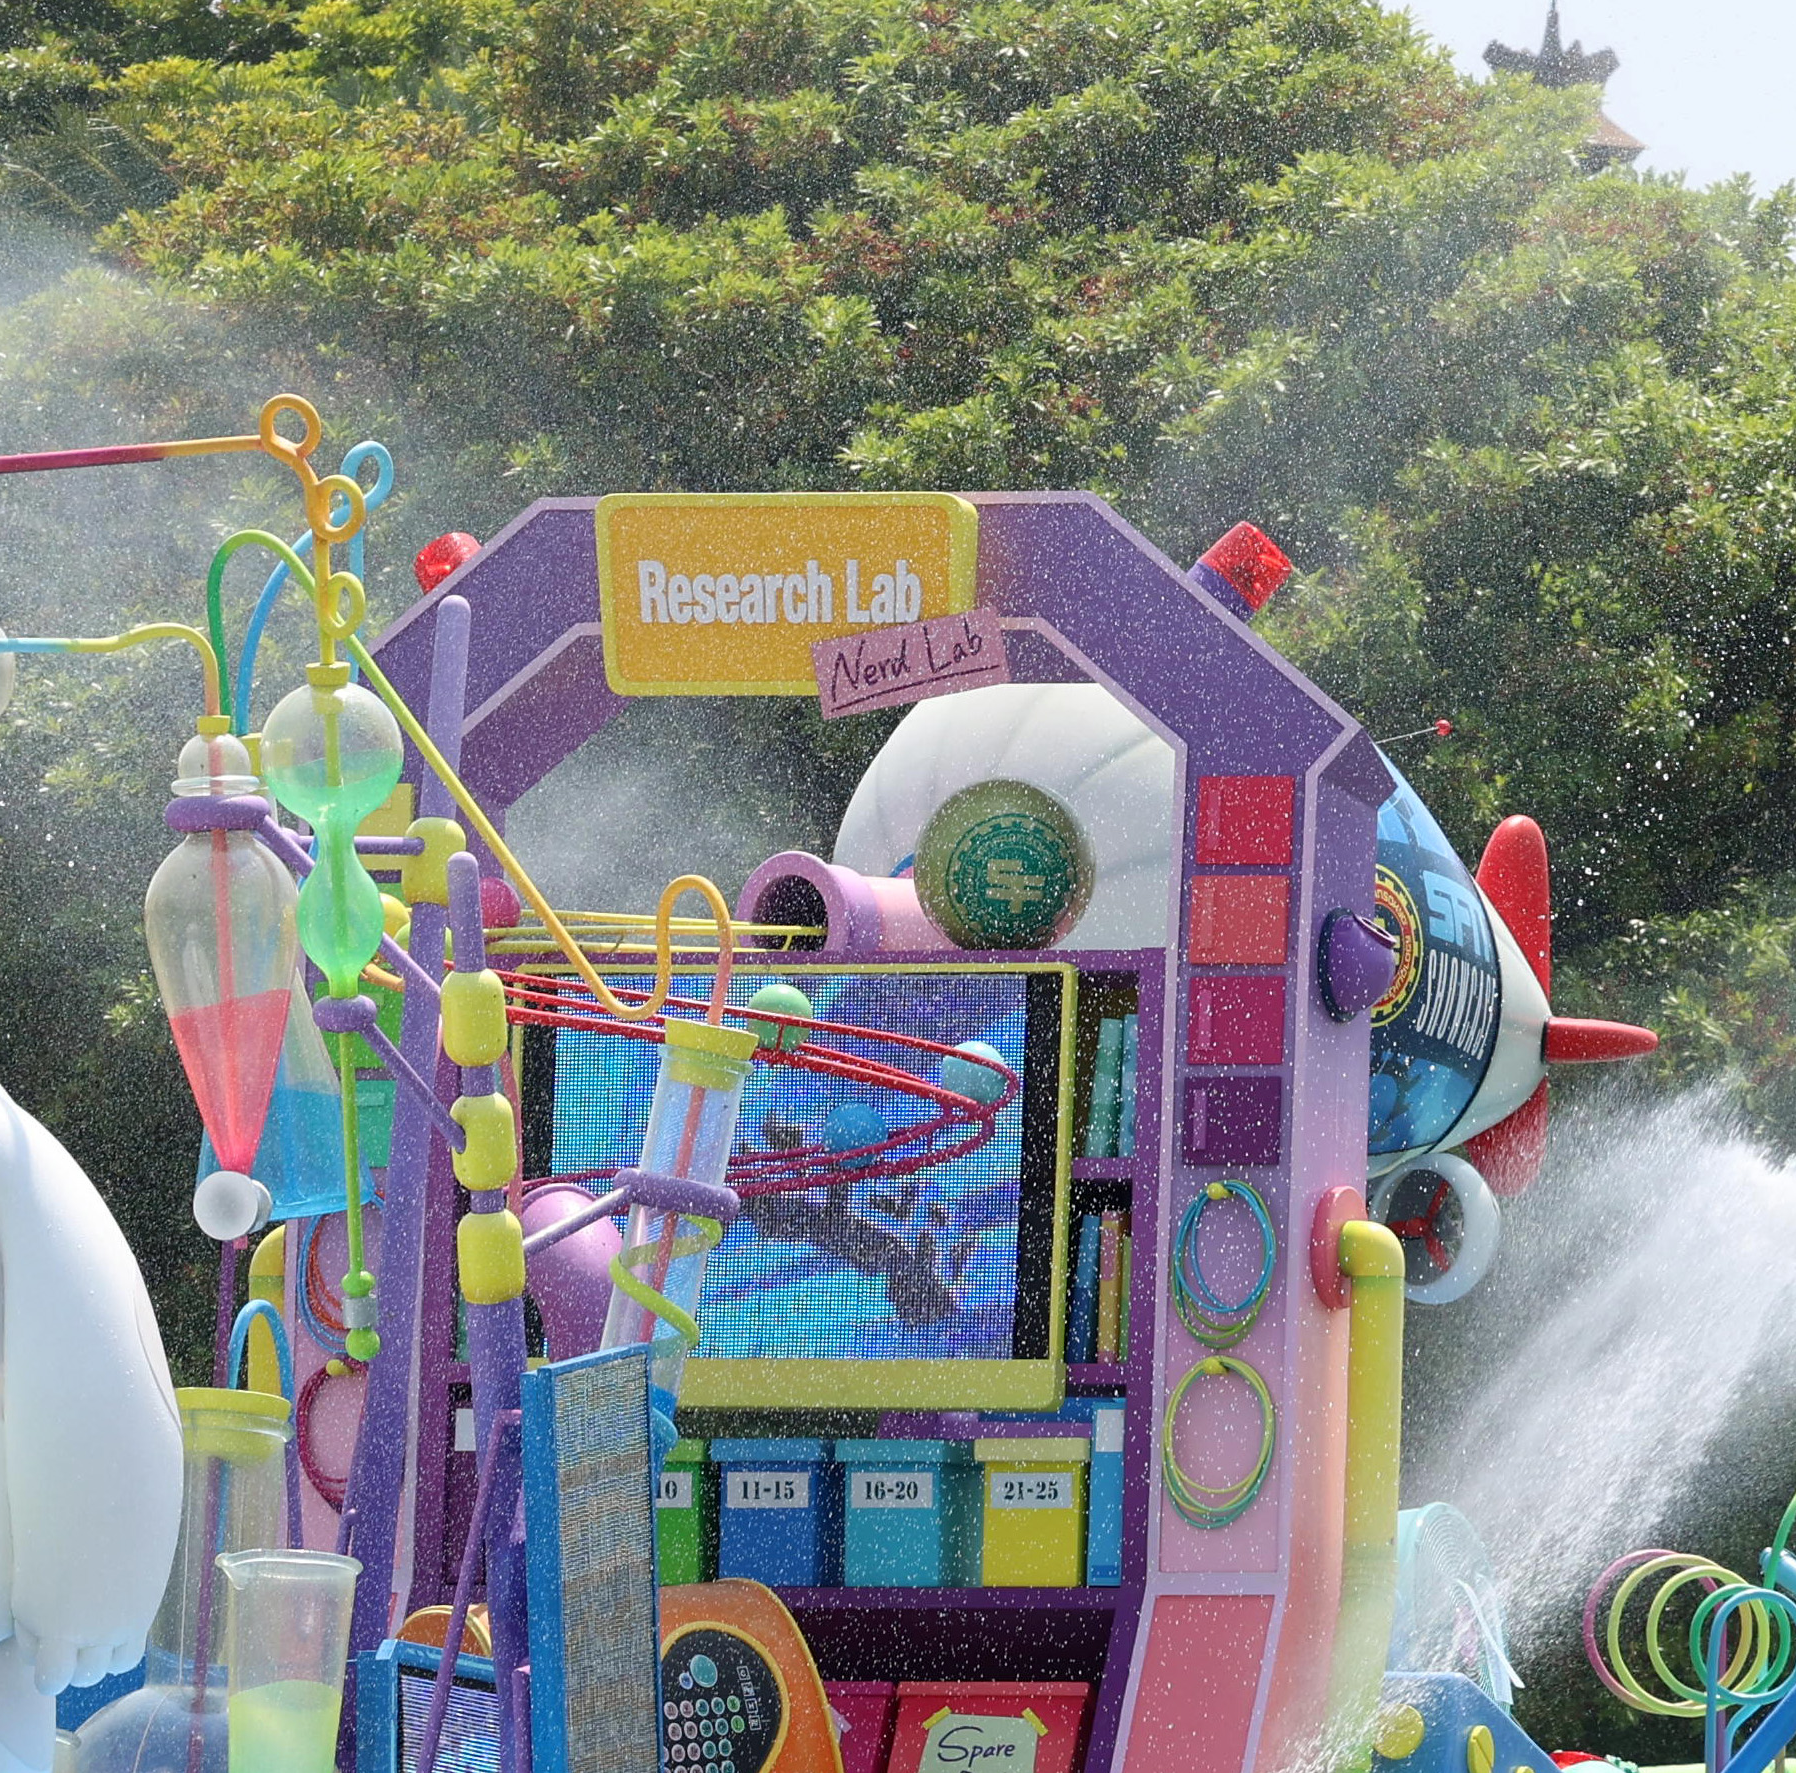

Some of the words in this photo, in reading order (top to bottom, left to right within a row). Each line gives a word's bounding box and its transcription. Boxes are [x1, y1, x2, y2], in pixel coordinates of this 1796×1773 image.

[637, 559, 833, 625] Research
[846, 559, 922, 625] Lab
[831, 638, 911, 703] Nerd
[922, 616, 983, 674] Lab
[1415, 948, 1497, 1061] SHOWCASE
[741, 1480, 796, 1500] 11-15
[864, 1480, 919, 1500] 16-20
[1003, 1480, 1059, 1500] 21-25
[937, 1725, 1016, 1769] Spare
